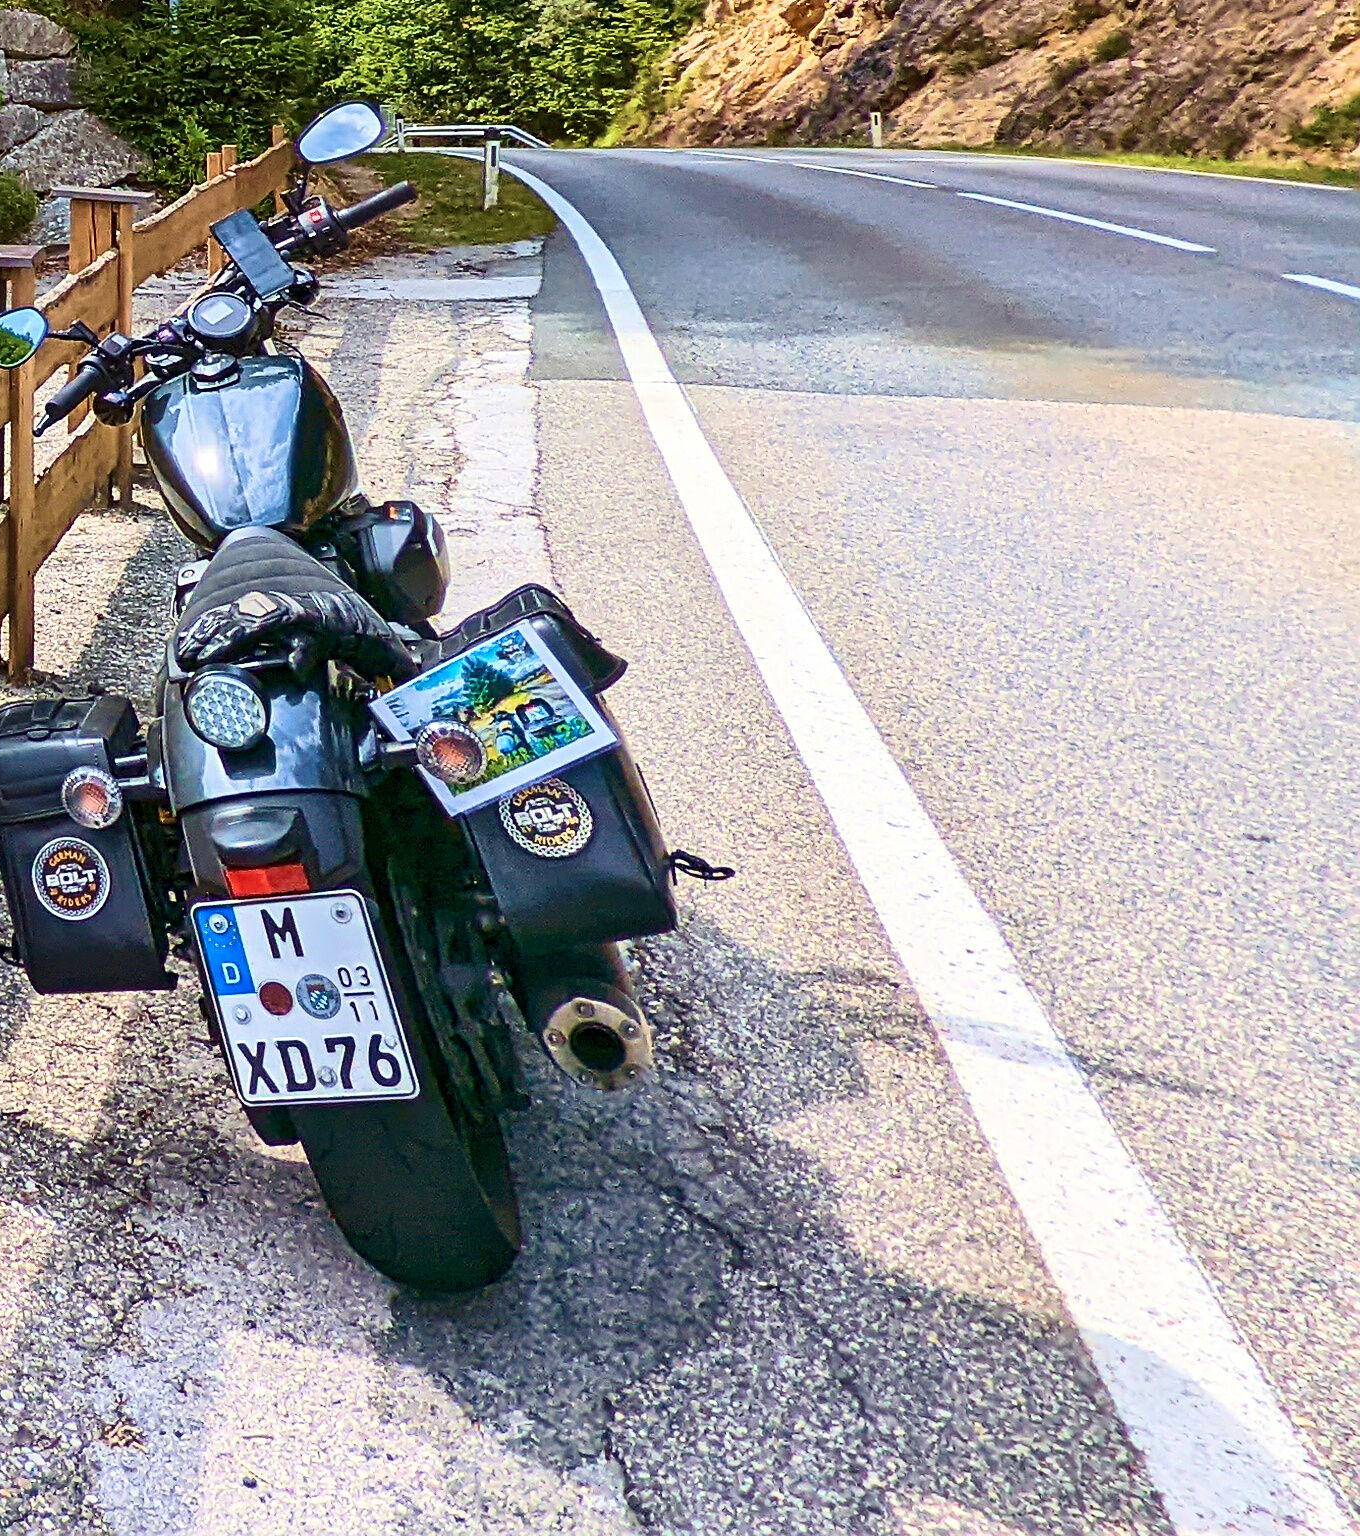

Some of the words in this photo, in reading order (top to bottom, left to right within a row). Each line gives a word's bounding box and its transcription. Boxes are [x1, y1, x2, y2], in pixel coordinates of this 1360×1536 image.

[514, 803, 573, 826] BOLT
[534, 827, 576, 846] RIDERS
[49, 850, 86, 867] GERMAN
[45, 869, 97, 887] BOLT
[56, 893, 92, 907] RIDERS
[260, 907, 305, 959] M
[221, 962, 241, 985] D
[337, 965, 371, 988] 03
[349, 1000, 380, 1023] 11
[236, 1039, 317, 1096] XD
[323, 1033, 402, 1090] 76
